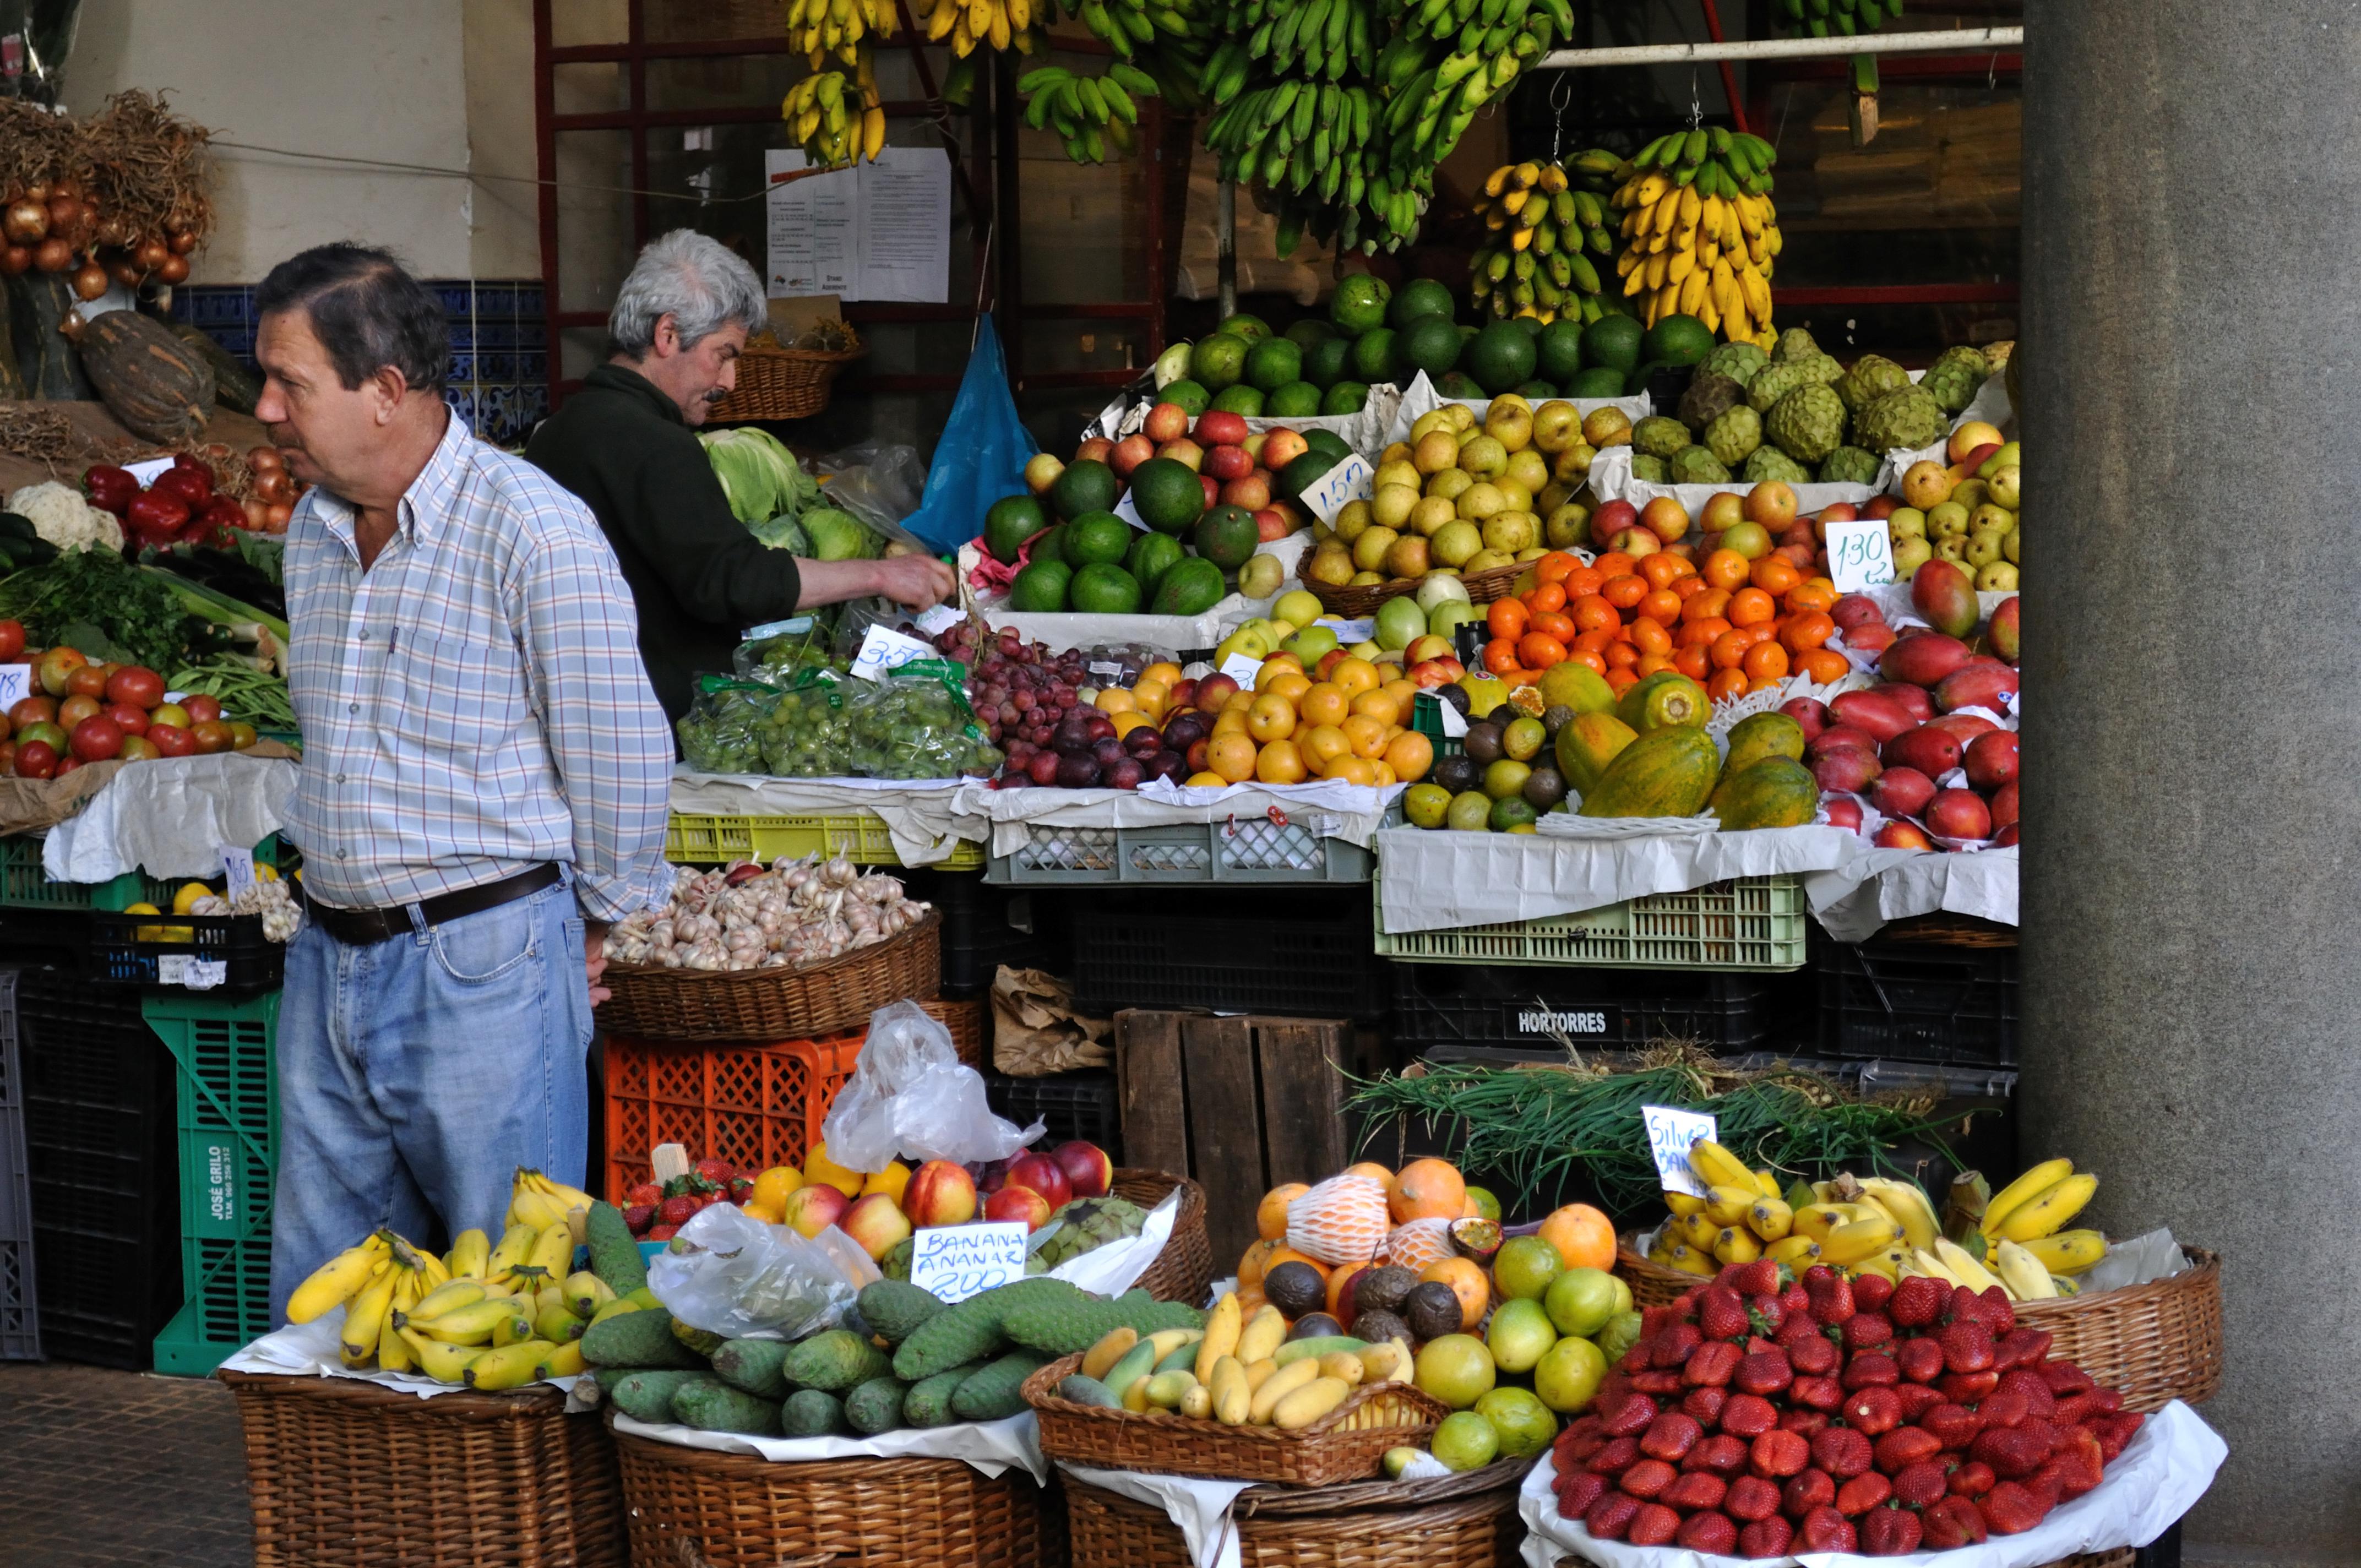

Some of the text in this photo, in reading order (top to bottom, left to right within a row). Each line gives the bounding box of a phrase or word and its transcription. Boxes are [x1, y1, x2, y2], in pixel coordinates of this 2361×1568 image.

[1519, 1011, 1606, 1033] HORTORRES
[208, 1146, 224, 1221] JOSÉ GRILO
[918, 1233, 1024, 1257] BANANA
